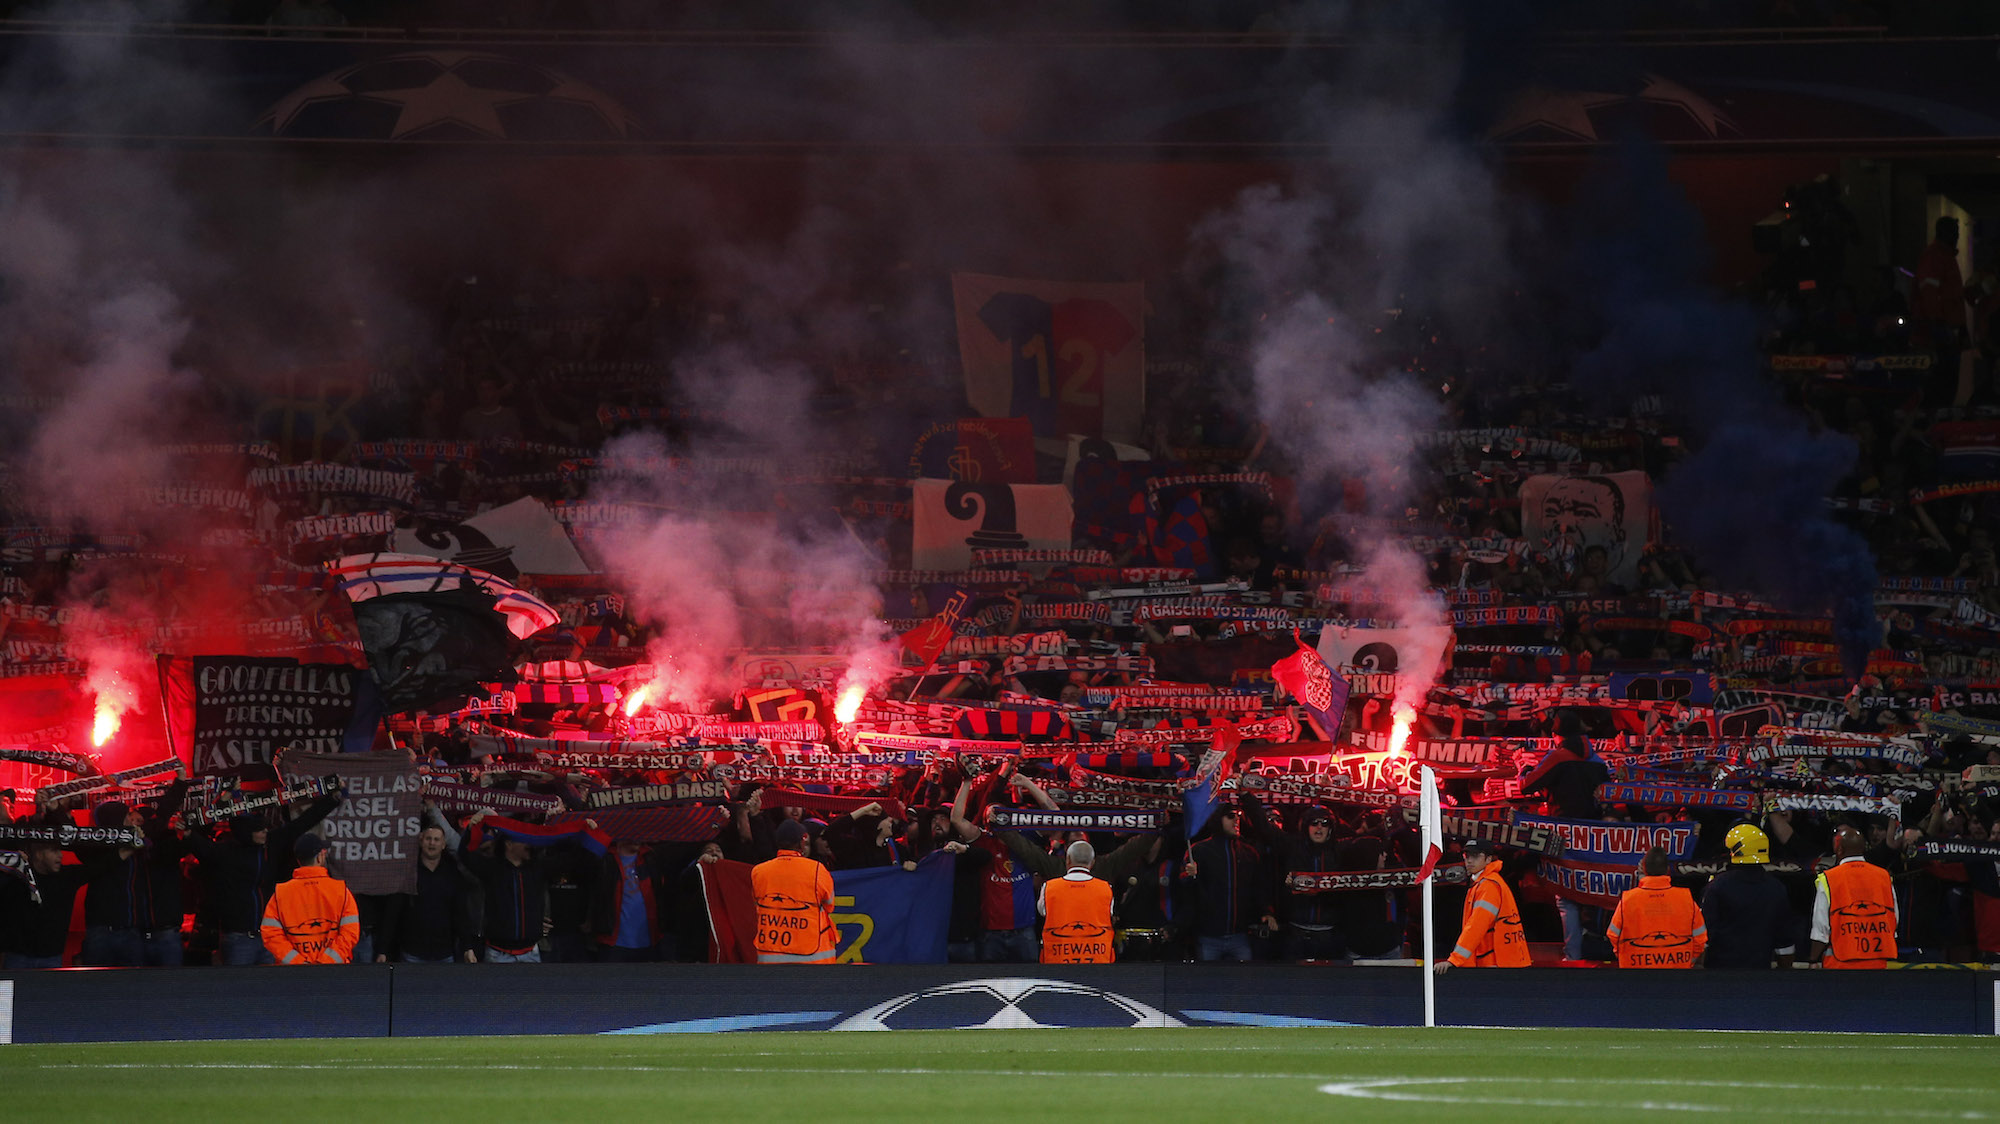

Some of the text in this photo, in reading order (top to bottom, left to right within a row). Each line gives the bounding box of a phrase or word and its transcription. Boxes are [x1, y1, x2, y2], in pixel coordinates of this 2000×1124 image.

[248, 462, 416, 491] MUTTENZERKURVE
[1243, 619, 1261, 633] FC
[200, 665, 351, 696] GOODFELLAS
[1939, 692, 1965, 708] FC
[225, 705, 314, 726] PRESENTS
[785, 751, 908, 766] FC BASEL 1893
[457, 788, 480, 802] wie
[592, 785, 672, 808] INFERNO
[1603, 784, 1749, 809] FANATICS
[1010, 808, 1157, 829] INFERNO BASEL
[324, 816, 421, 840] DRUG IS
[1403, 808, 1550, 853] FNATICS
[330, 841, 407, 862] TBALL
[1925, 842, 1939, 855] 10
[760, 914, 809, 930] EWARD
[1840, 921, 1891, 937] STEWAR
[758, 928, 792, 947] 690
[1854, 936, 1883, 953] 702
[1051, 943, 1106, 956] STEWARD
[1630, 951, 1692, 967] STEWARD
